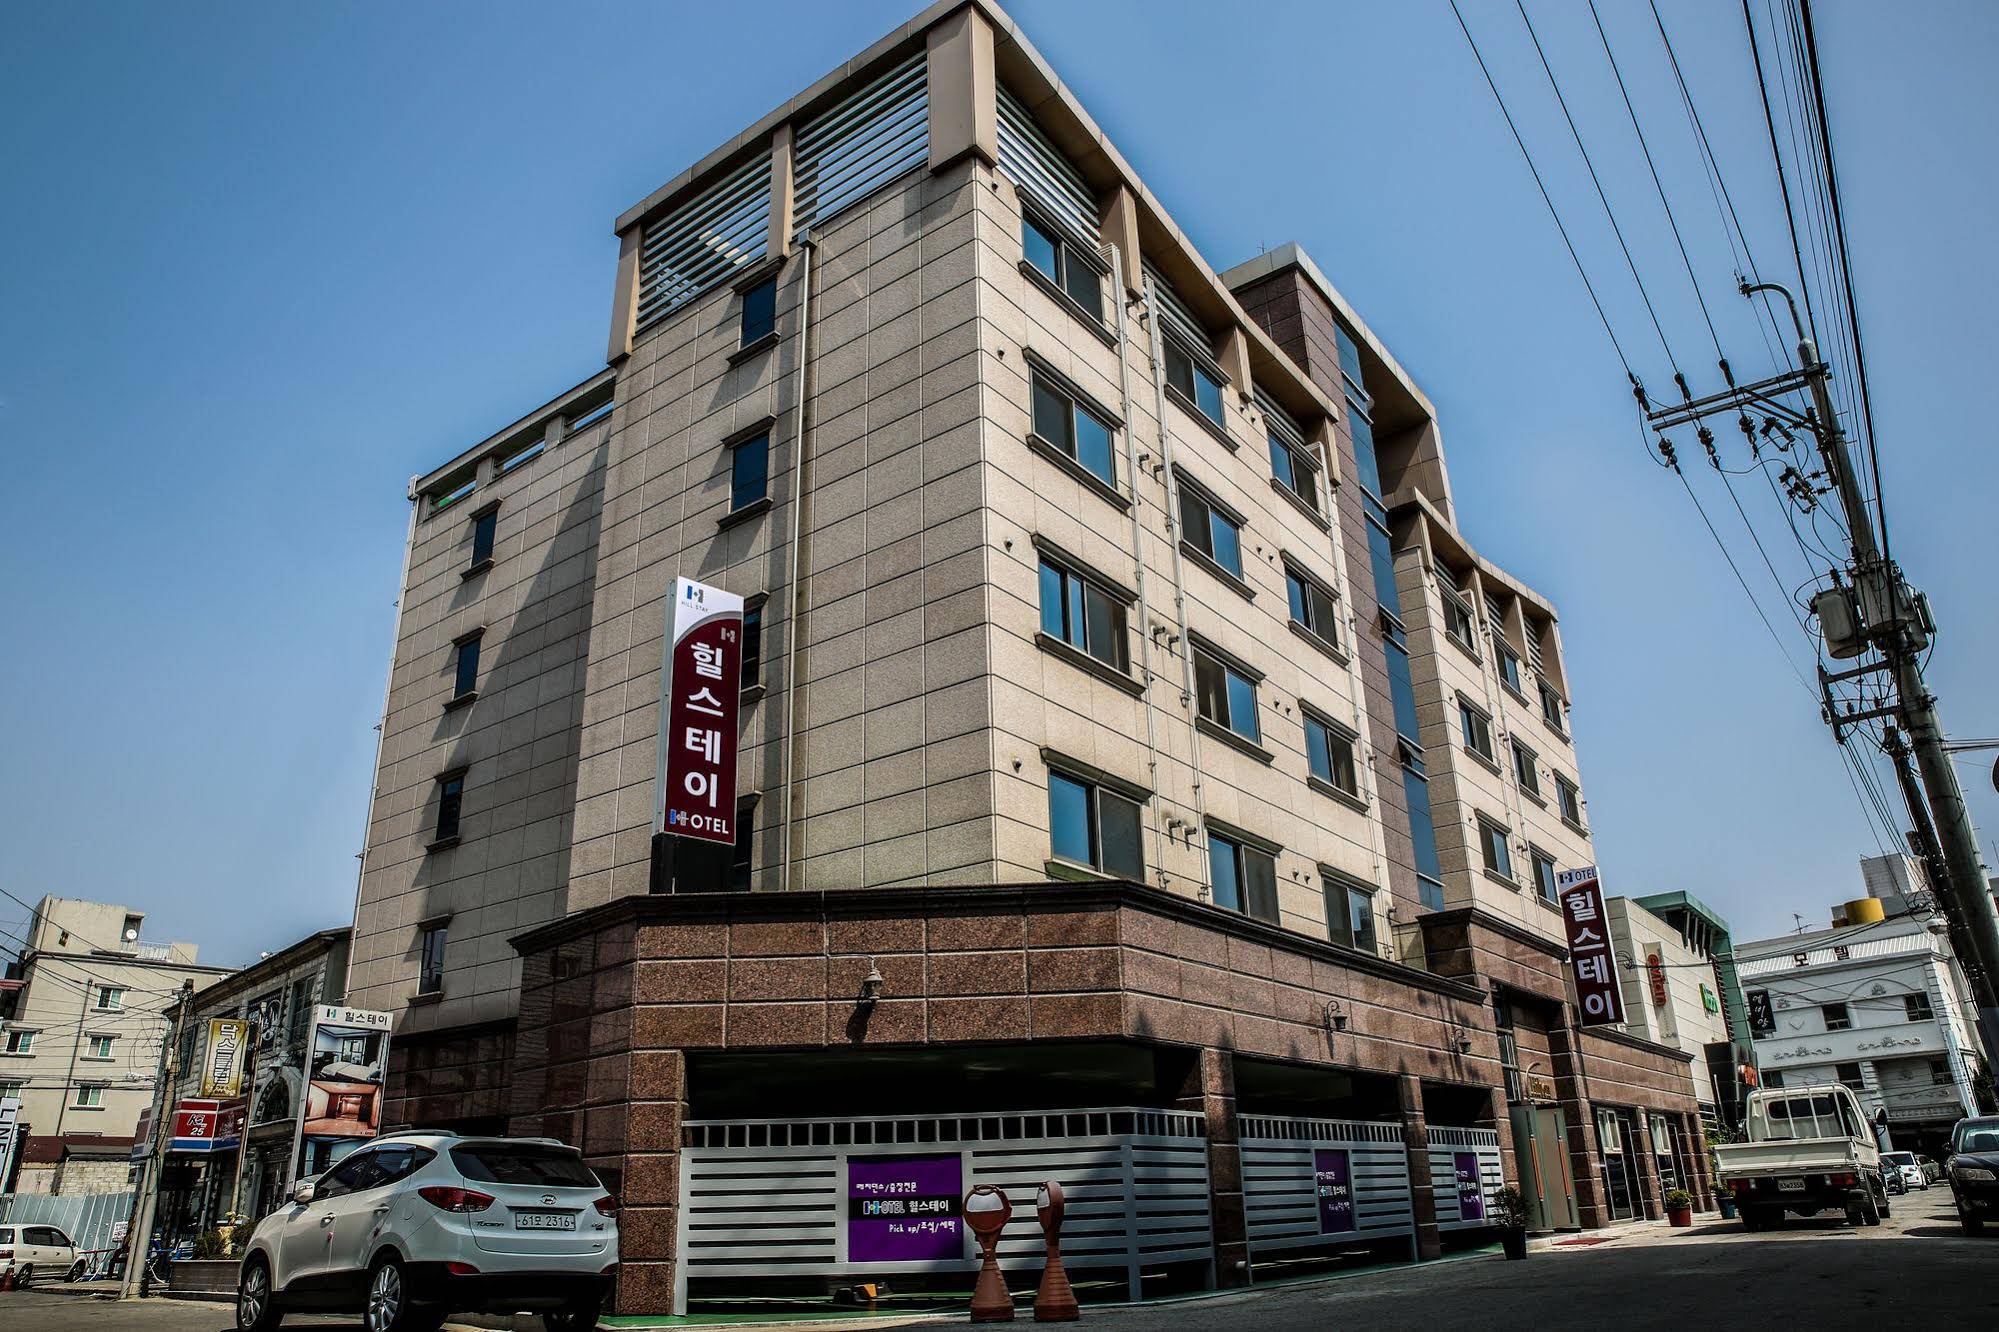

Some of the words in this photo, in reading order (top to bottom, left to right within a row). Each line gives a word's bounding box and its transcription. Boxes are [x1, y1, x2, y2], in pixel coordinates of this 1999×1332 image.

[684, 641, 724, 808] 힐스테이
[1566, 891, 1615, 1020] 힐스테이
[345, 1011, 388, 1026] 힐스테이
[190, 1127, 204, 1136] 25
[909, 1200, 949, 1213] 힐스테이
[546, 1215, 570, 1227] 2316
[889, 1224, 904, 1233] Pick
